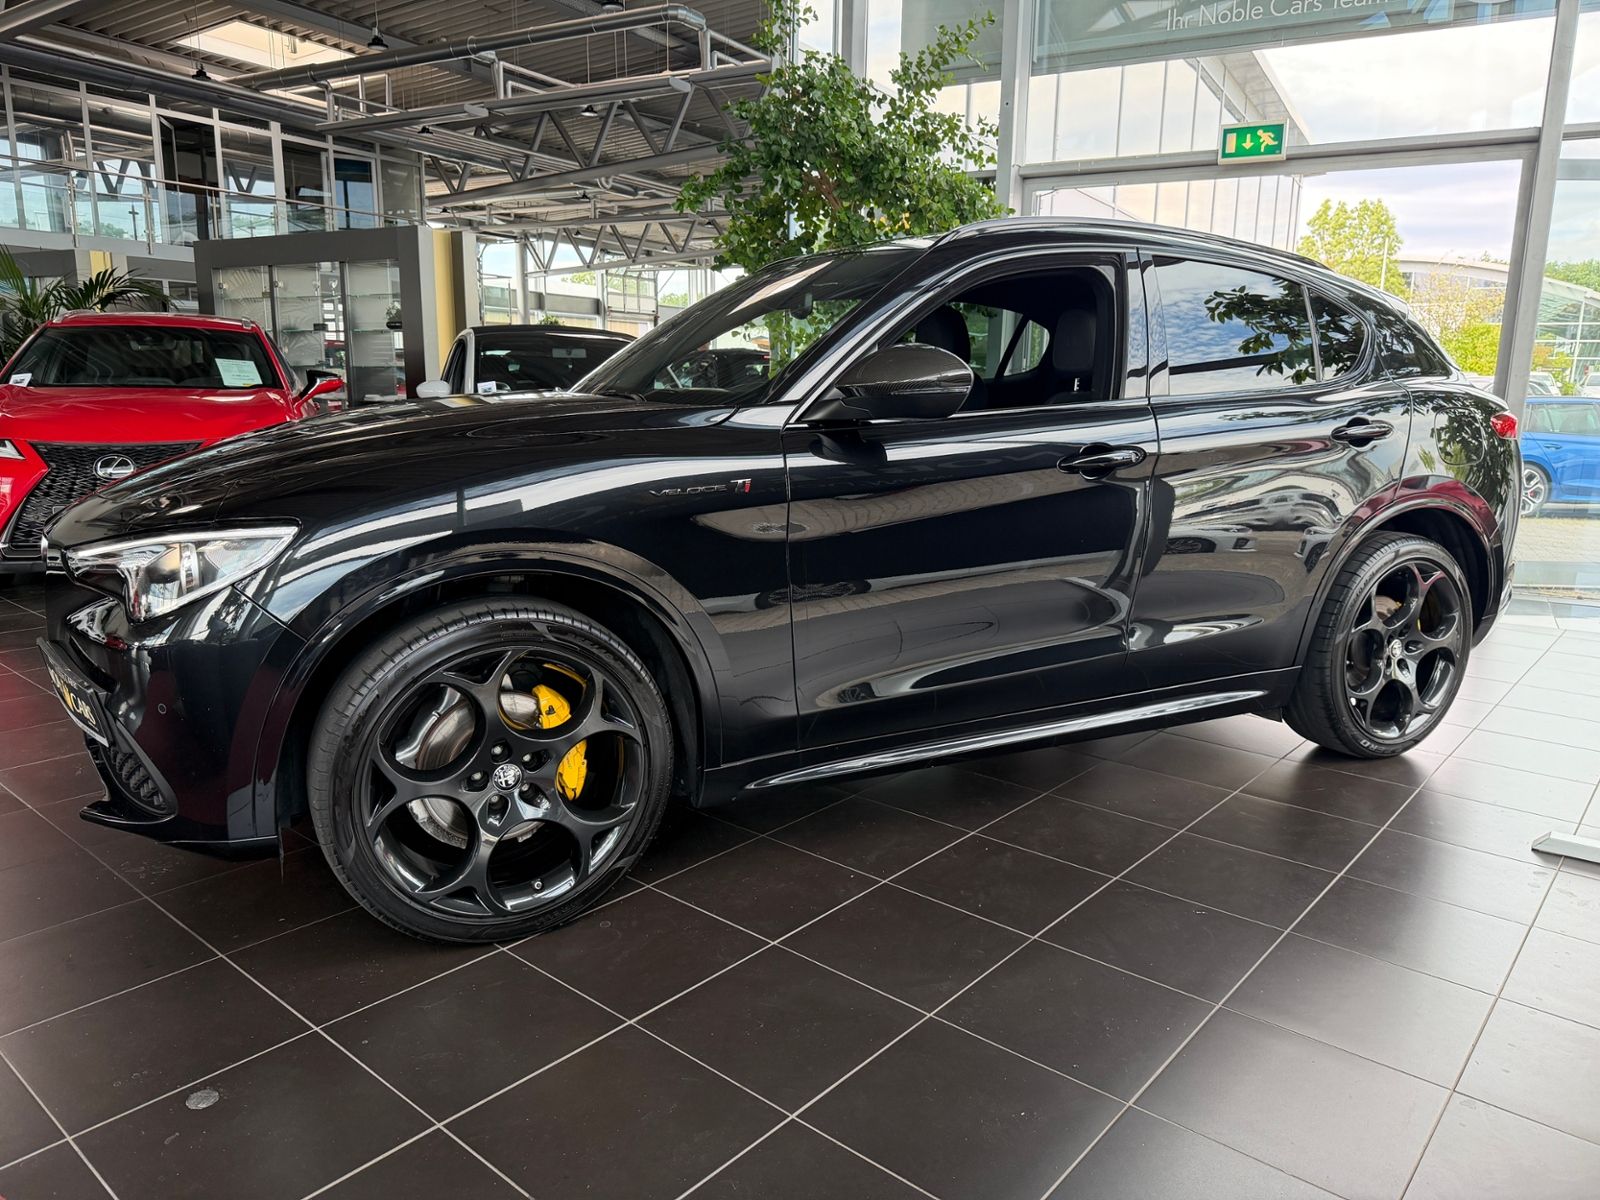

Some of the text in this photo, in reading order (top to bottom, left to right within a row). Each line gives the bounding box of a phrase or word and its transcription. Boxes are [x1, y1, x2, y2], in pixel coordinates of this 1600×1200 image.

[1166, 8, 1192, 31] Ihr
[1199, 0, 1263, 27] Noble
[1270, 0, 1323, 17] Cars
[649, 484, 728, 497] VELOCE
